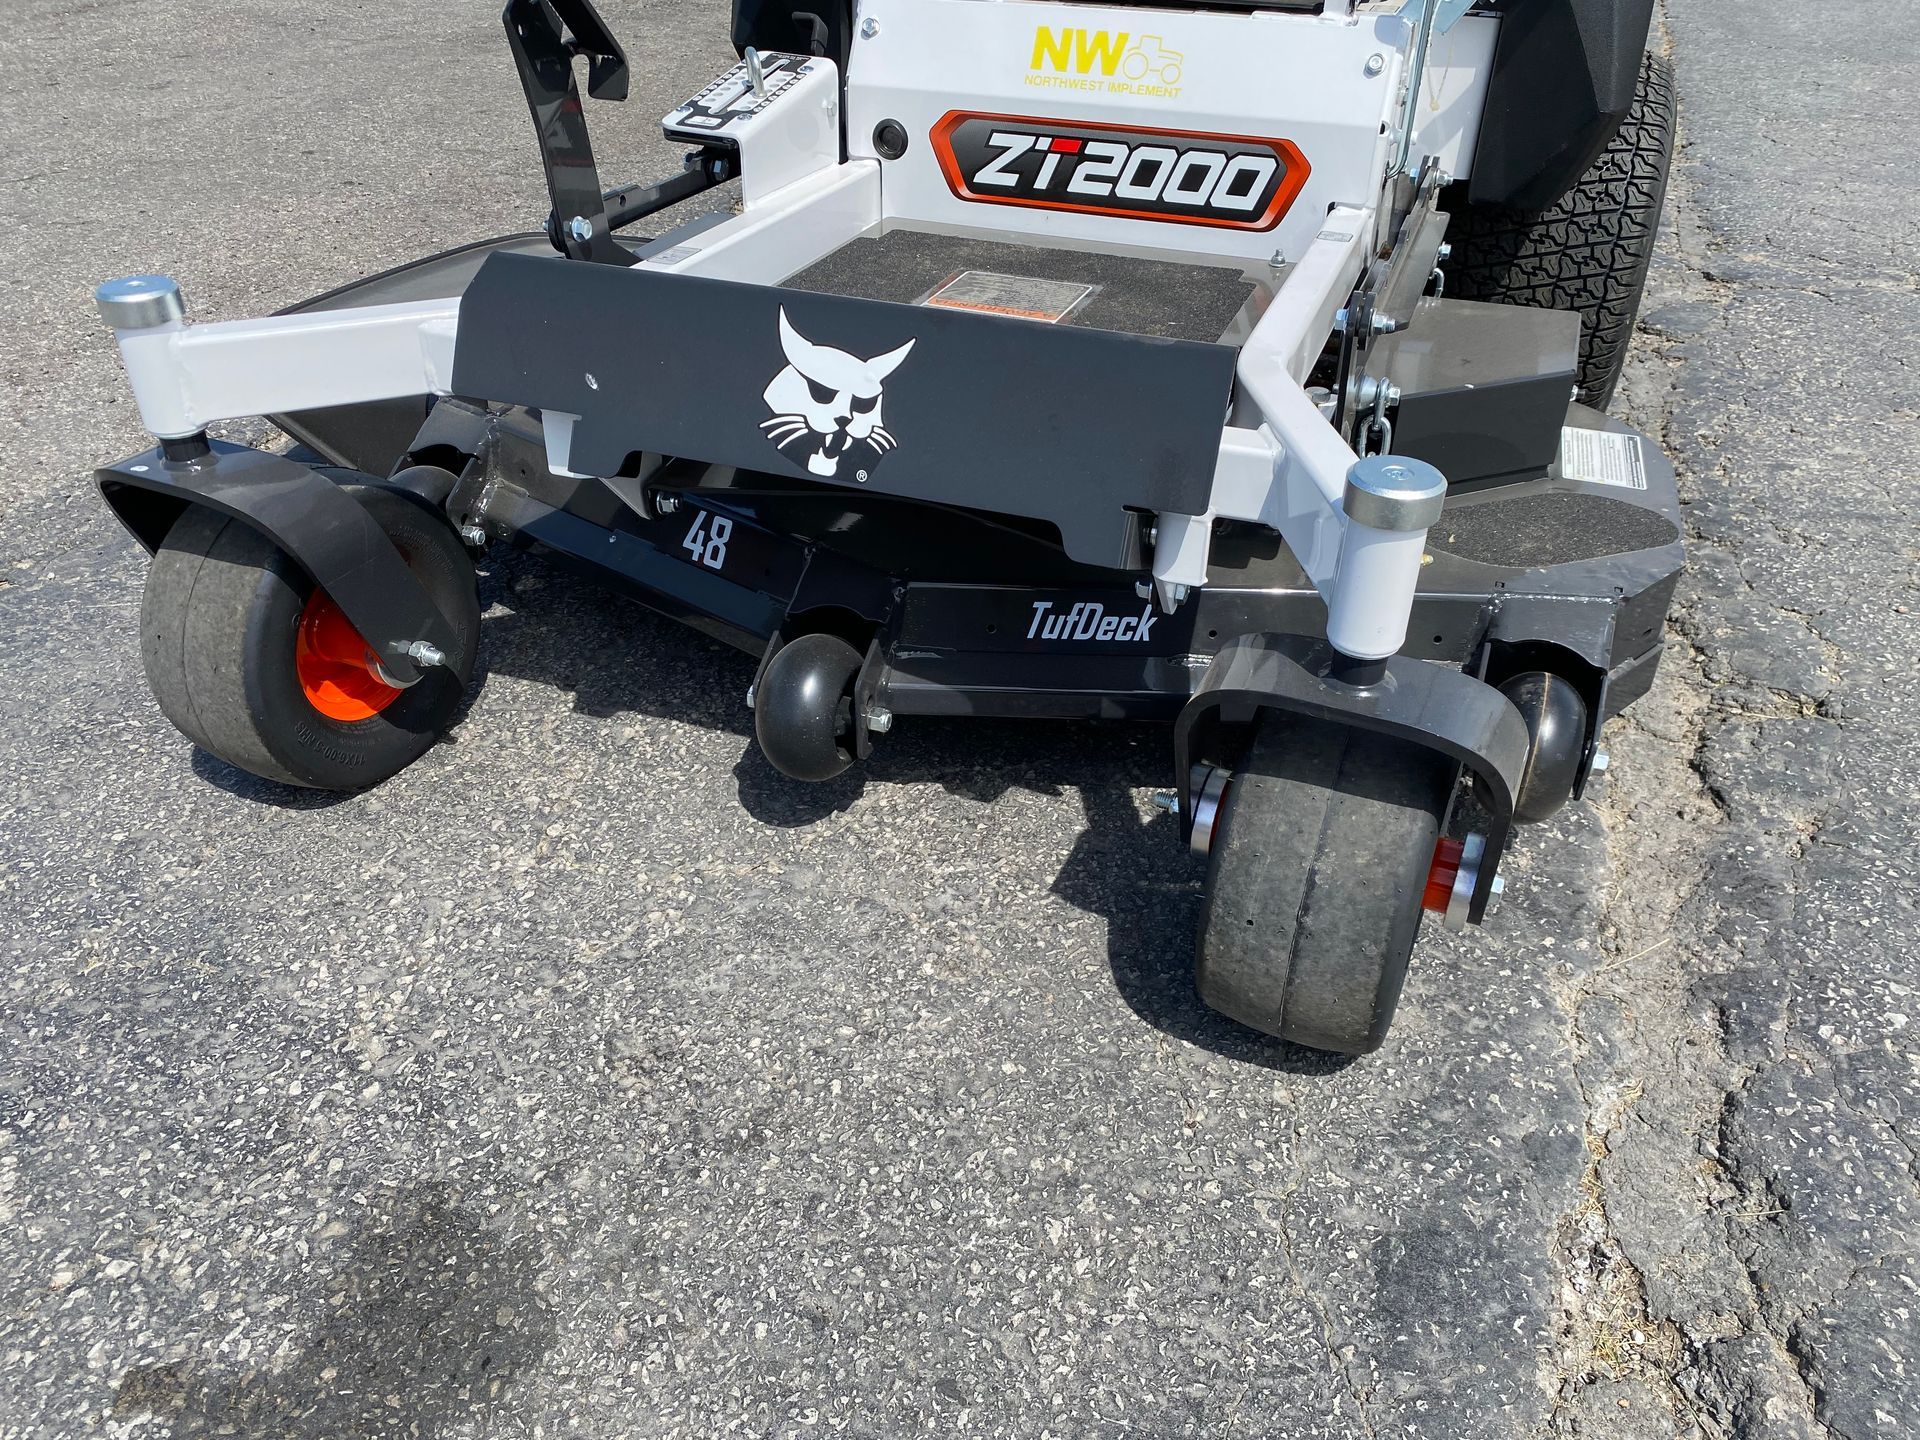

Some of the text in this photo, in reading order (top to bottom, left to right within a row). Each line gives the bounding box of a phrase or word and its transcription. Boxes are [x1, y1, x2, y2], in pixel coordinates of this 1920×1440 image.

[1029, 25, 1130, 77] NW
[1024, 74, 1182, 99] NORTHWEST IMPLEMENT
[972, 132, 1279, 212] ZT2000
[682, 510, 733, 570] 48
[1026, 601, 1158, 642] TufDeck
